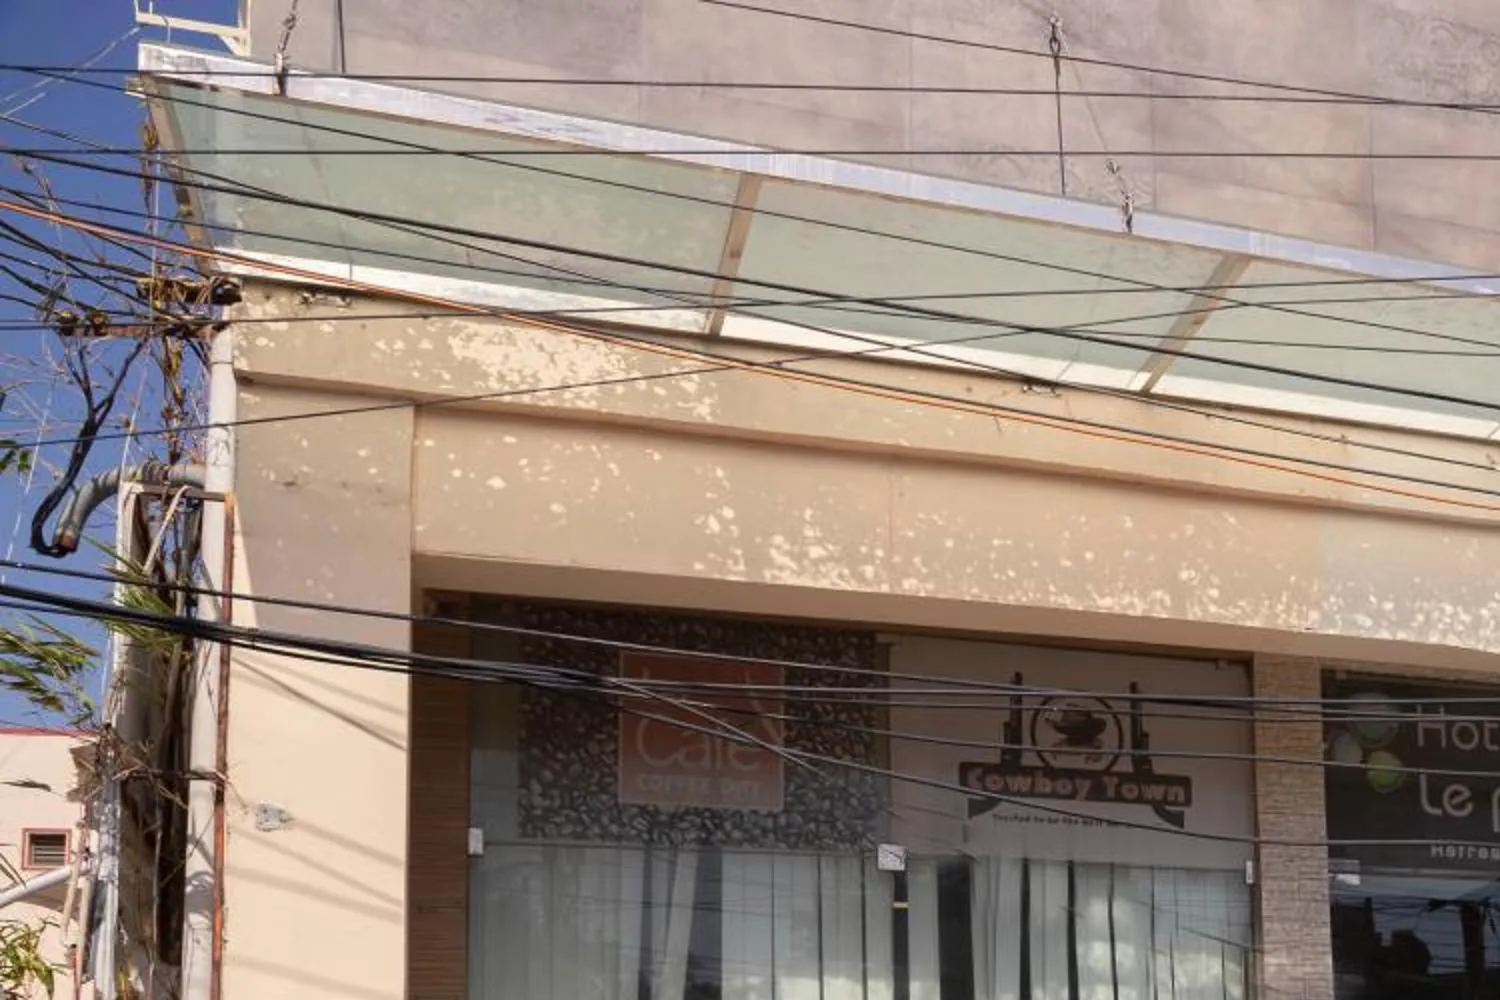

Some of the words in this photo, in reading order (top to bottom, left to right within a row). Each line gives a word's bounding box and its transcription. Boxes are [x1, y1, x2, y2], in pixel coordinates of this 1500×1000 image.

[966, 766, 1091, 801] Cowboy
[1101, 775, 1187, 805] Town
[1418, 768, 1474, 817] Le
